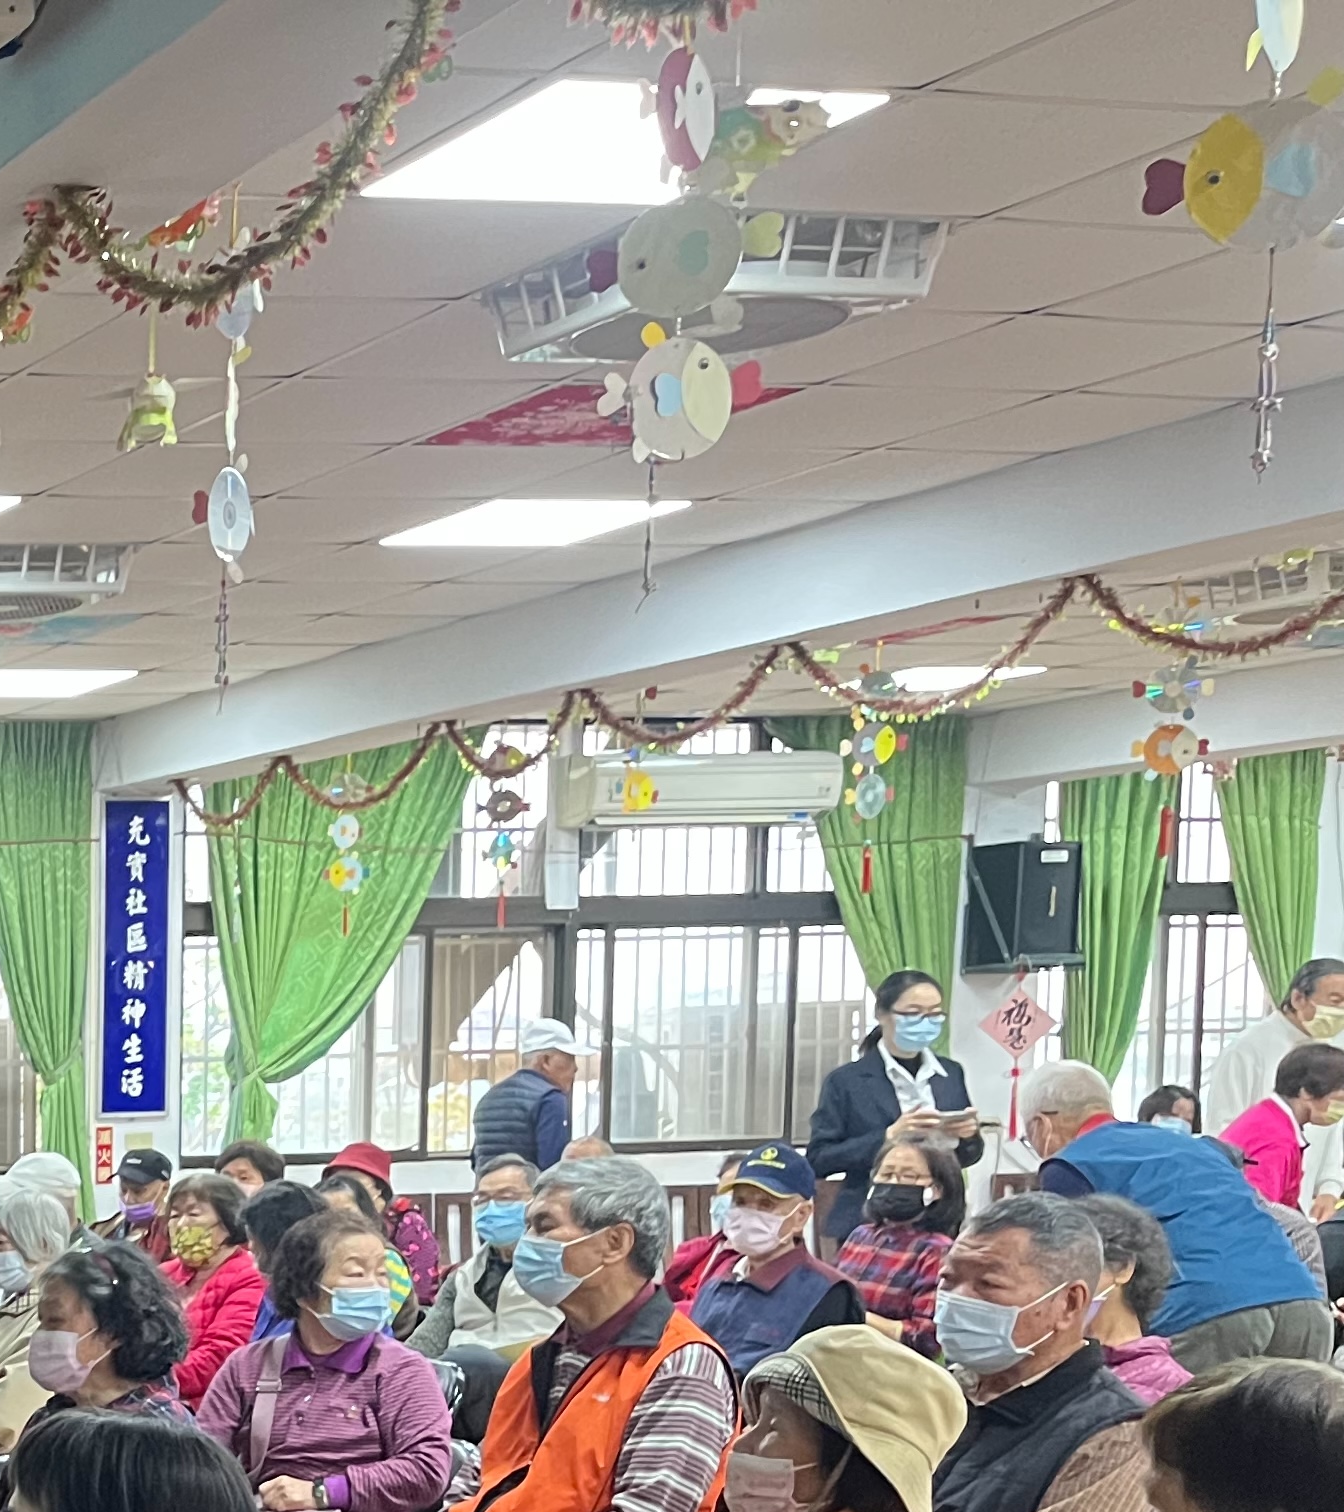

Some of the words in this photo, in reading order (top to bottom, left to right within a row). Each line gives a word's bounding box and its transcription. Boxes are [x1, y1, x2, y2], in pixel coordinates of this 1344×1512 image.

[120, 815, 151, 1098] 充實社區精神生活
